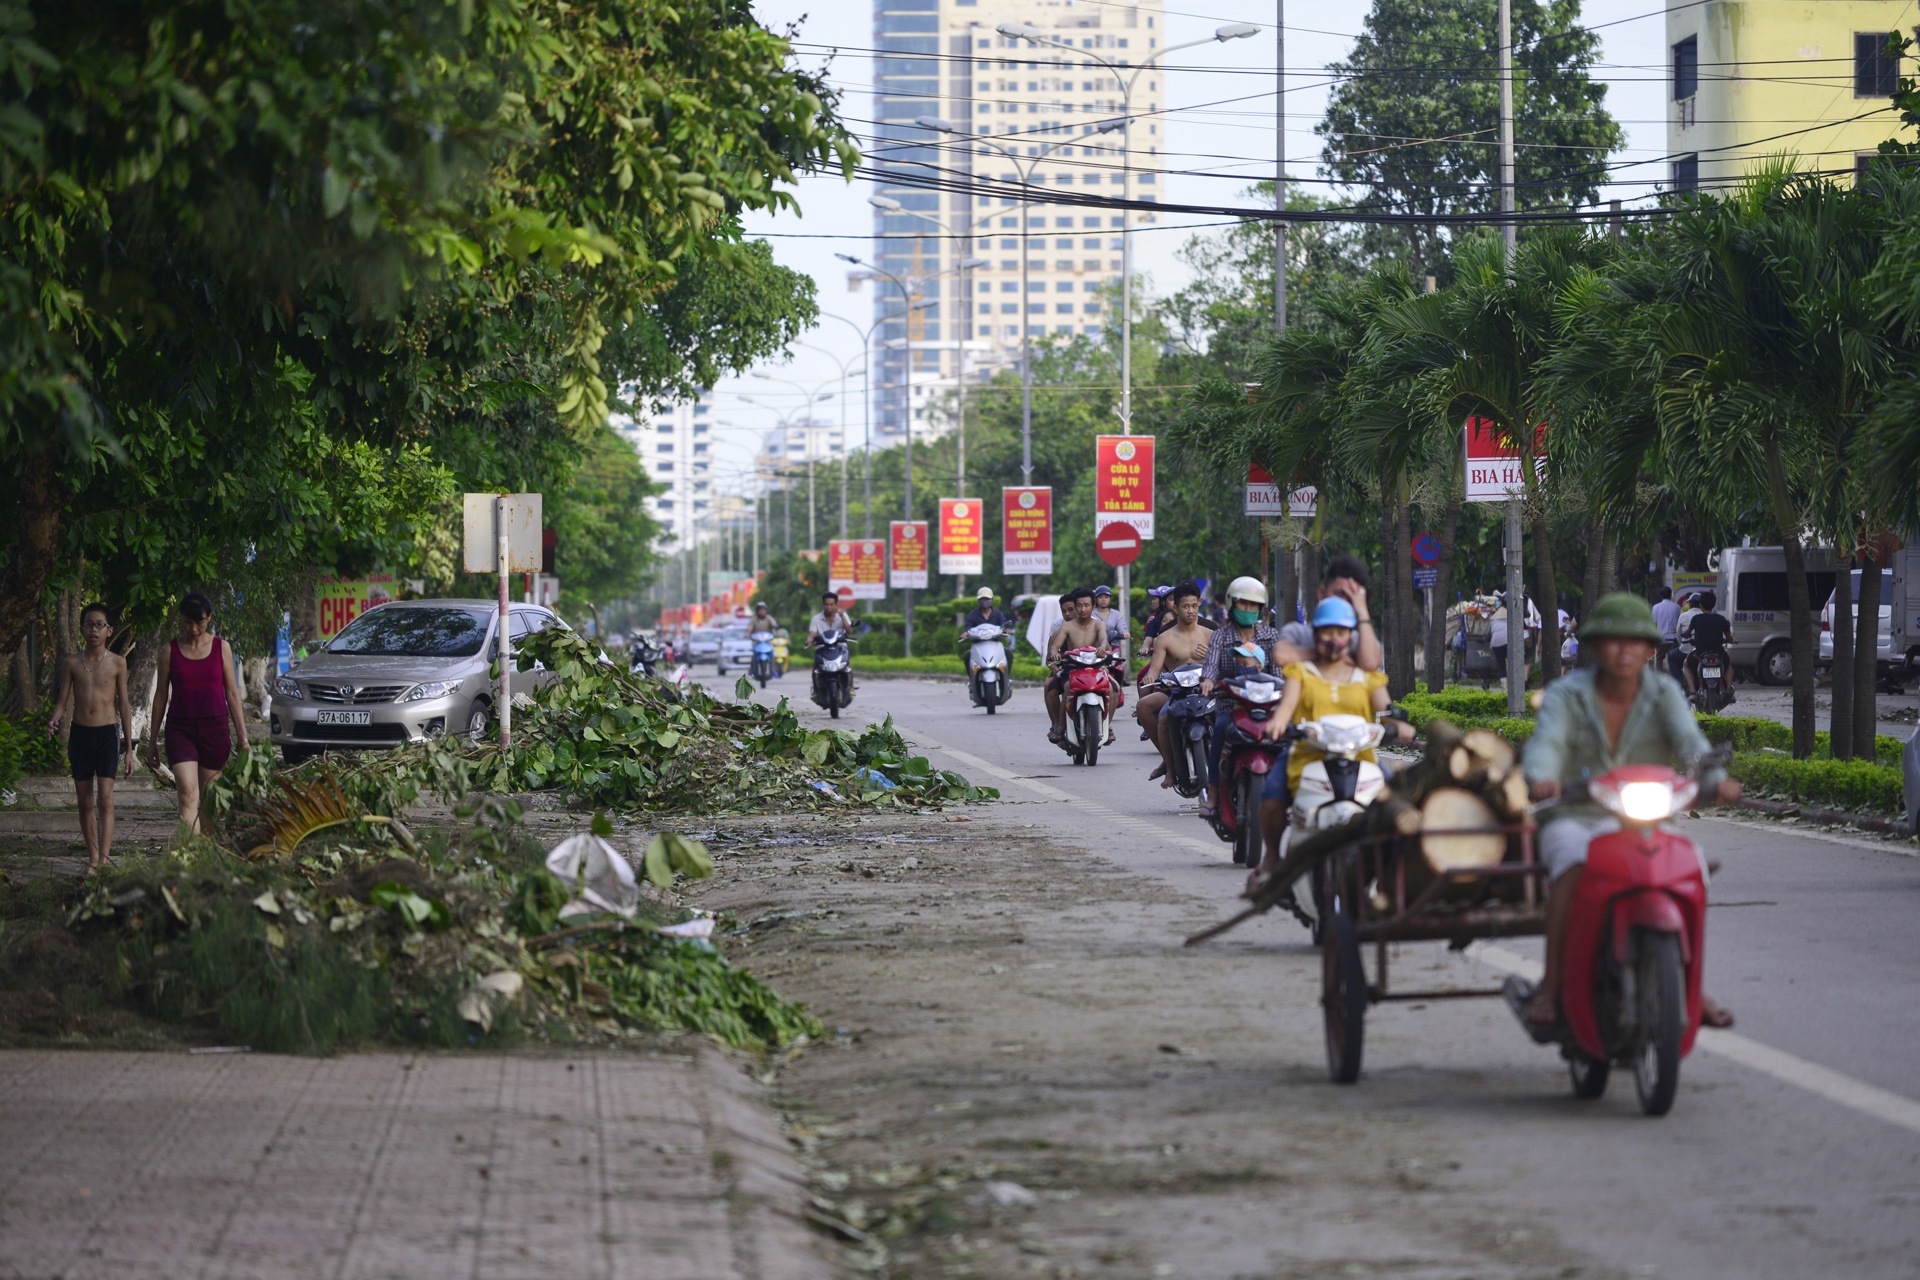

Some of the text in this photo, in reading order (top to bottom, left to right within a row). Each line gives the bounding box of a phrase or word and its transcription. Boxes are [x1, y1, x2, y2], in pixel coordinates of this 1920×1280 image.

[1110, 462, 1141, 474] CỬA LÒ
[1111, 476, 1139, 487] HỘI TỤ
[1471, 468, 1499, 484] BIA
[1119, 488, 1131, 498] VÀ
[1249, 491, 1270, 503] BIA
[1104, 498, 1145, 511] TỎA SÁNG
[1020, 540, 1035, 549] 2017
[320, 589, 356, 635] CHÈ
[320, 712, 369, 724] 37A-061.17
